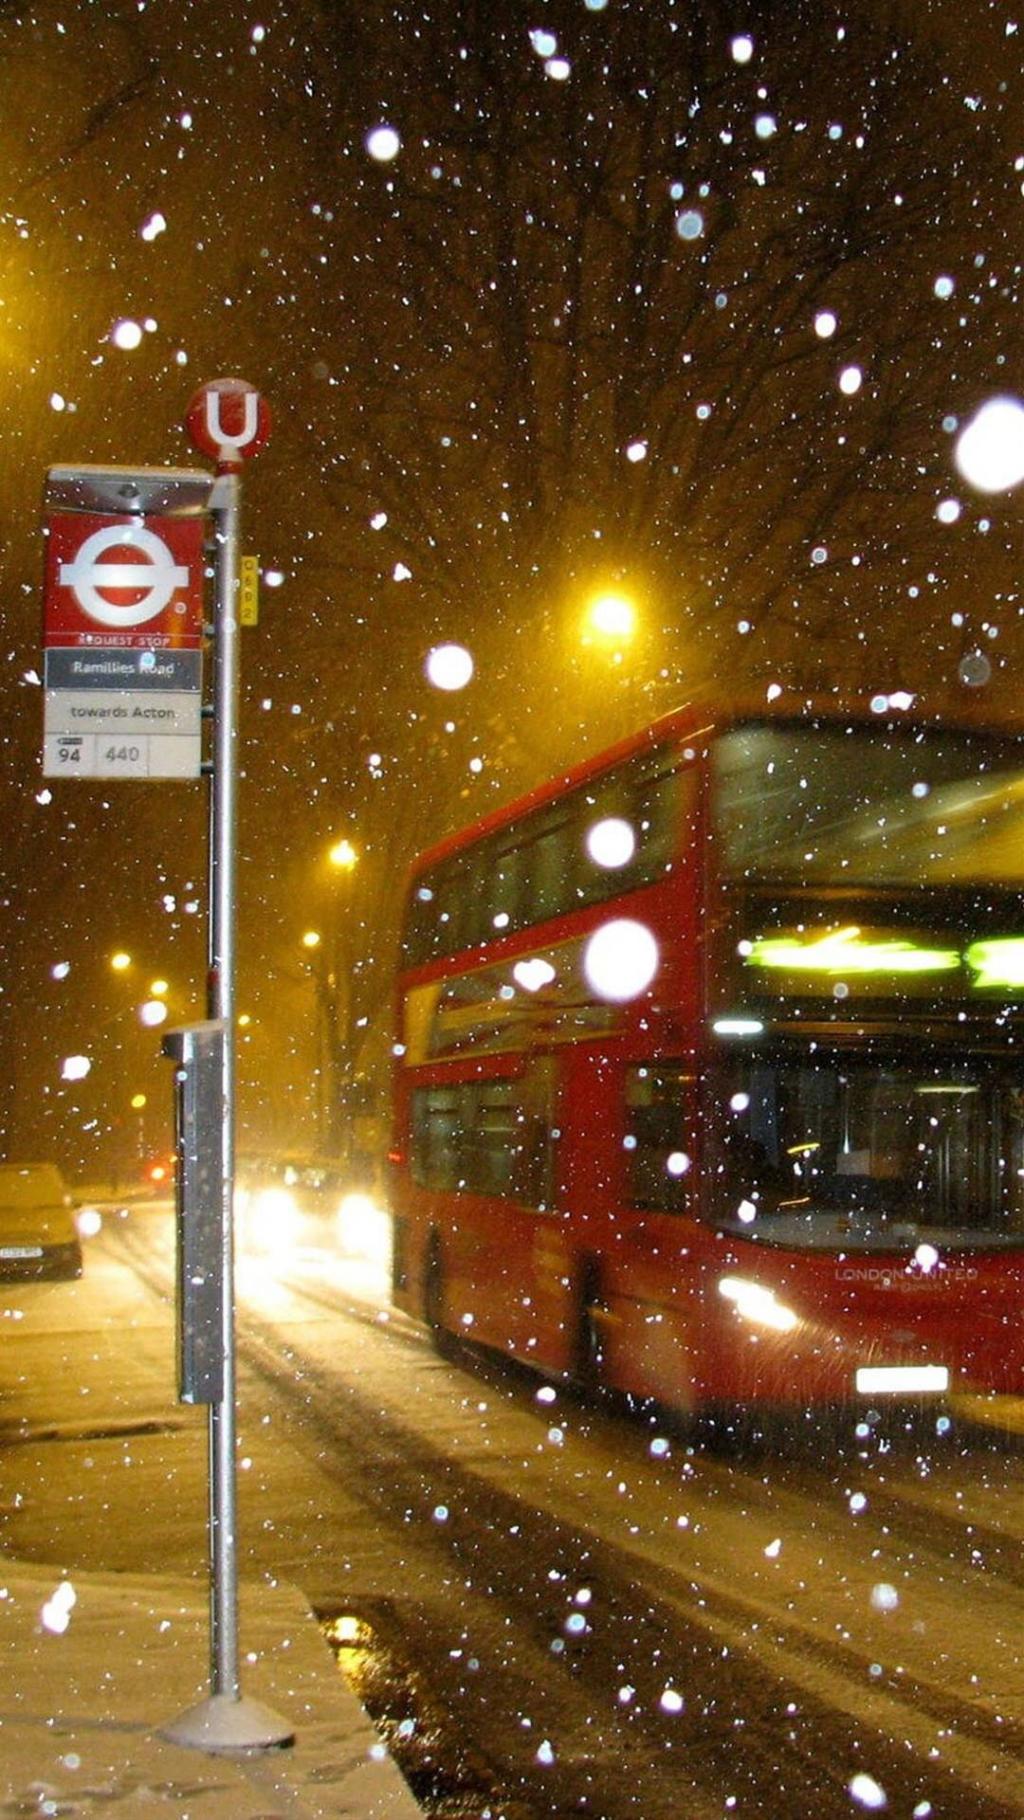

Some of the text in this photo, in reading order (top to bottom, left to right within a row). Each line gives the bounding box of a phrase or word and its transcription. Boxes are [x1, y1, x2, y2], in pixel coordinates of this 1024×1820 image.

[78, 636, 171, 647] REQUEST STOP
[73, 661, 136, 674] Ramillies
[71, 706, 176, 719] towards Acton
[58, 748, 81, 762] 94
[105, 747, 140, 762] 440
[835, 1268, 979, 1281] LONDON UNITED
